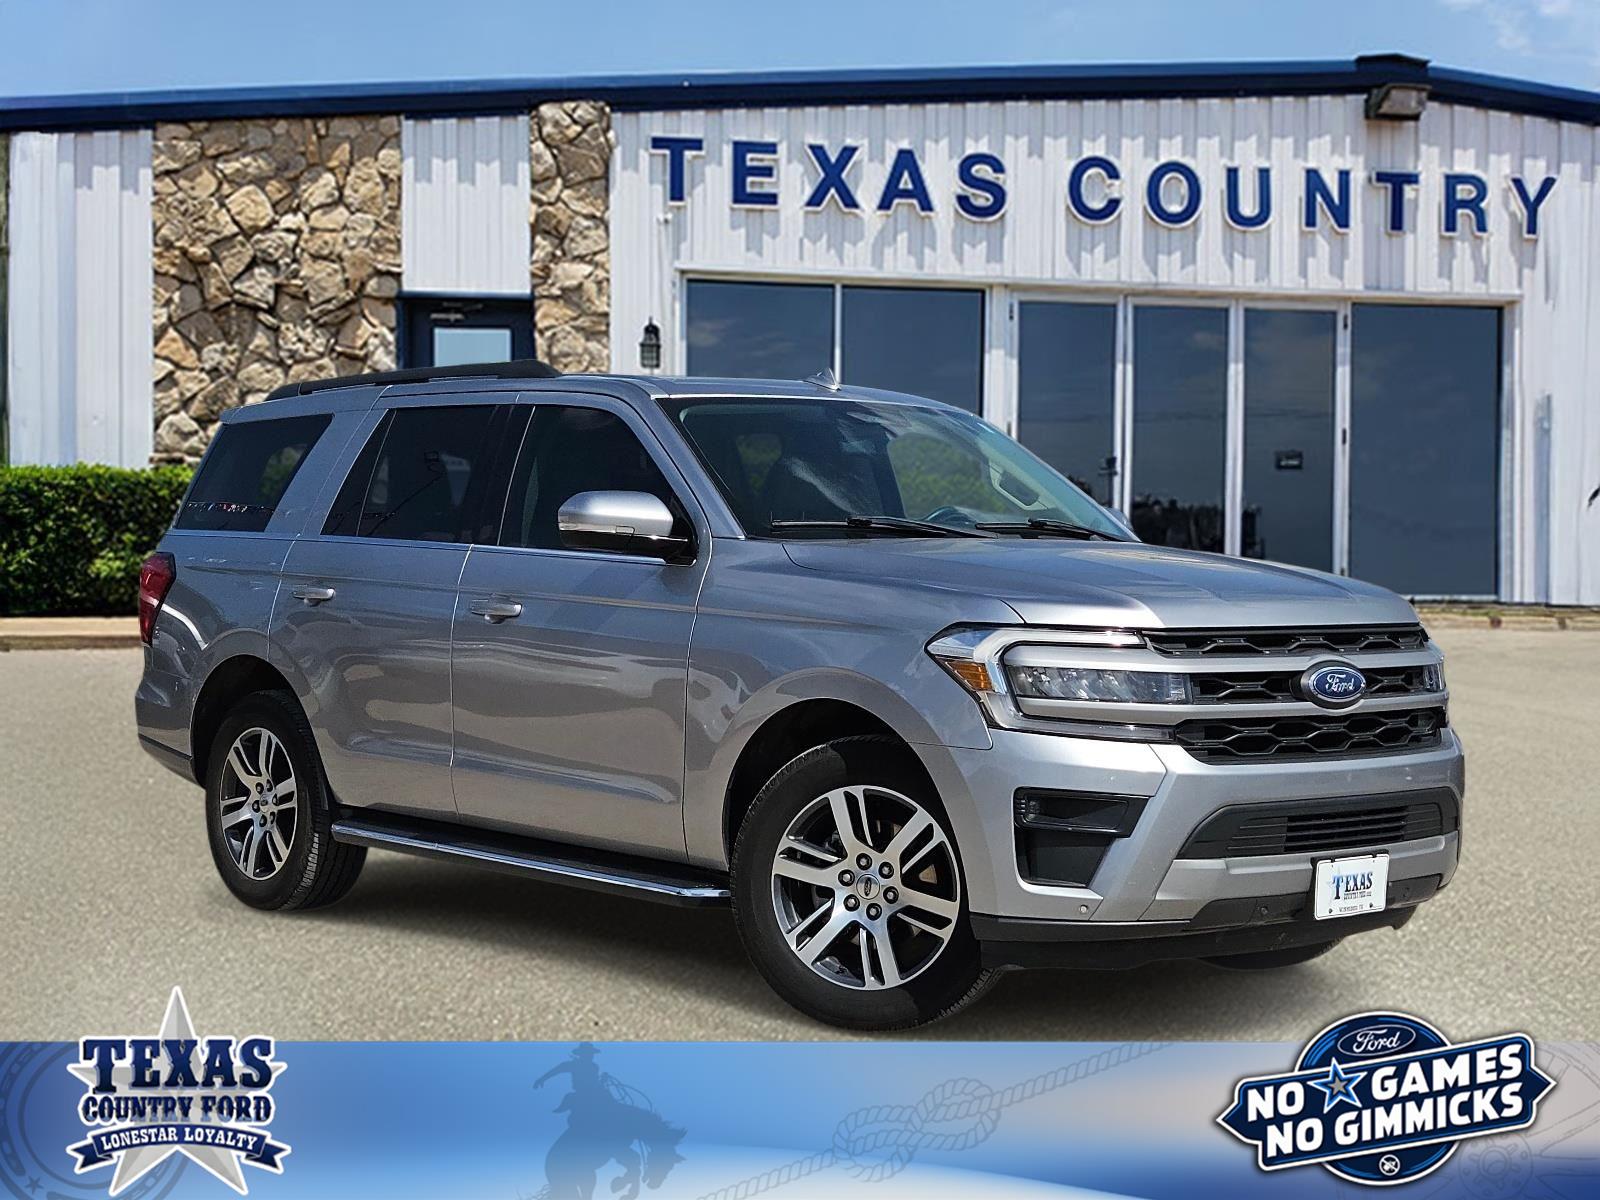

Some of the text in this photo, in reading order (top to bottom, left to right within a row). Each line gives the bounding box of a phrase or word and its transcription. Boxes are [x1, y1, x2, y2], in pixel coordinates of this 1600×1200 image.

[651, 136, 1557, 238] TEXAS COUNTRY
[1325, 673, 1355, 693] Ford
[1332, 872, 1373, 899] TEXAS
